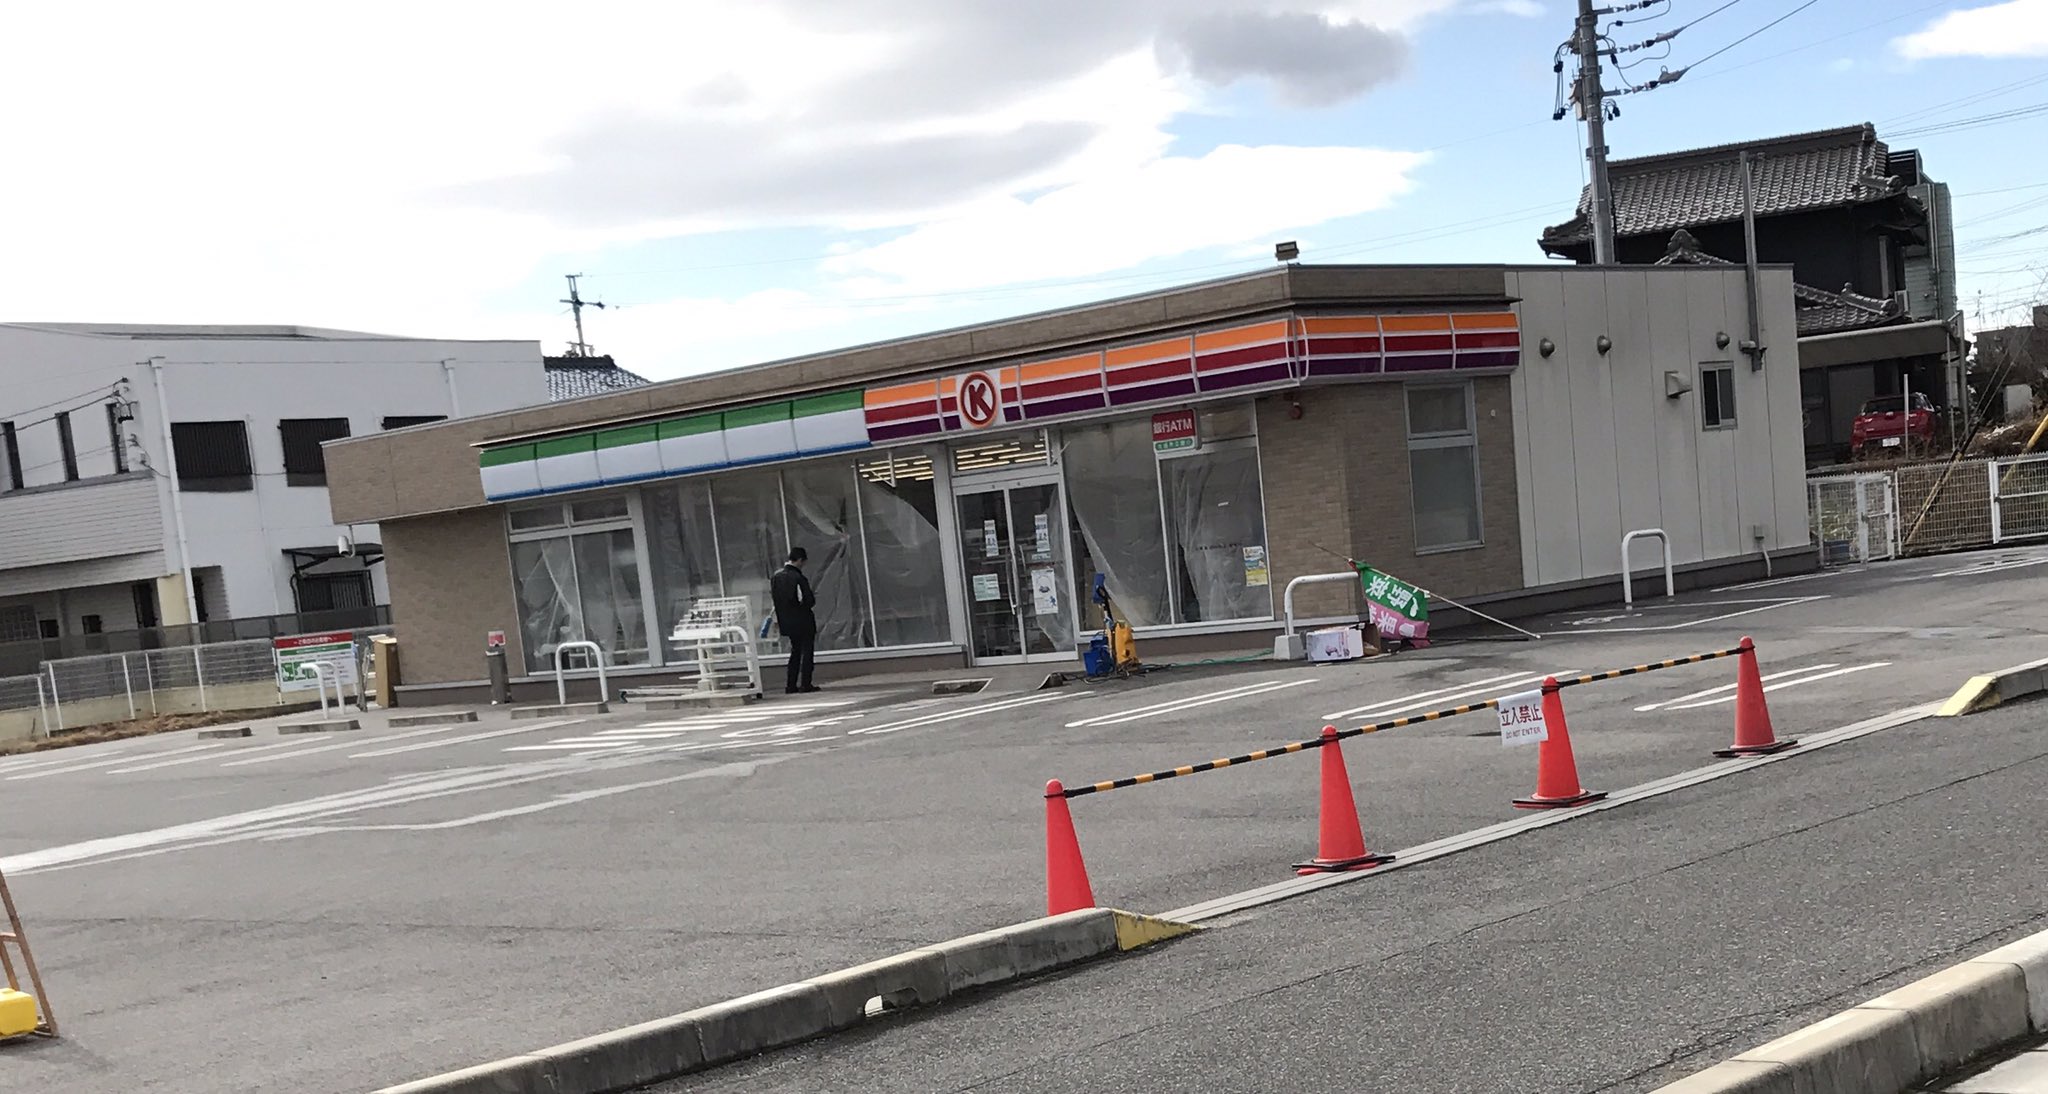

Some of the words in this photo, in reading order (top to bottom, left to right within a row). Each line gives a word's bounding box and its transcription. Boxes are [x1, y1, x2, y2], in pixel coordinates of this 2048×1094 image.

[967, 380, 994, 421] K
[1365, 575, 1413, 610] 野菜
[1501, 704, 1542, 726] 立入禁止
[1521, 727, 1542, 736] ENTER
